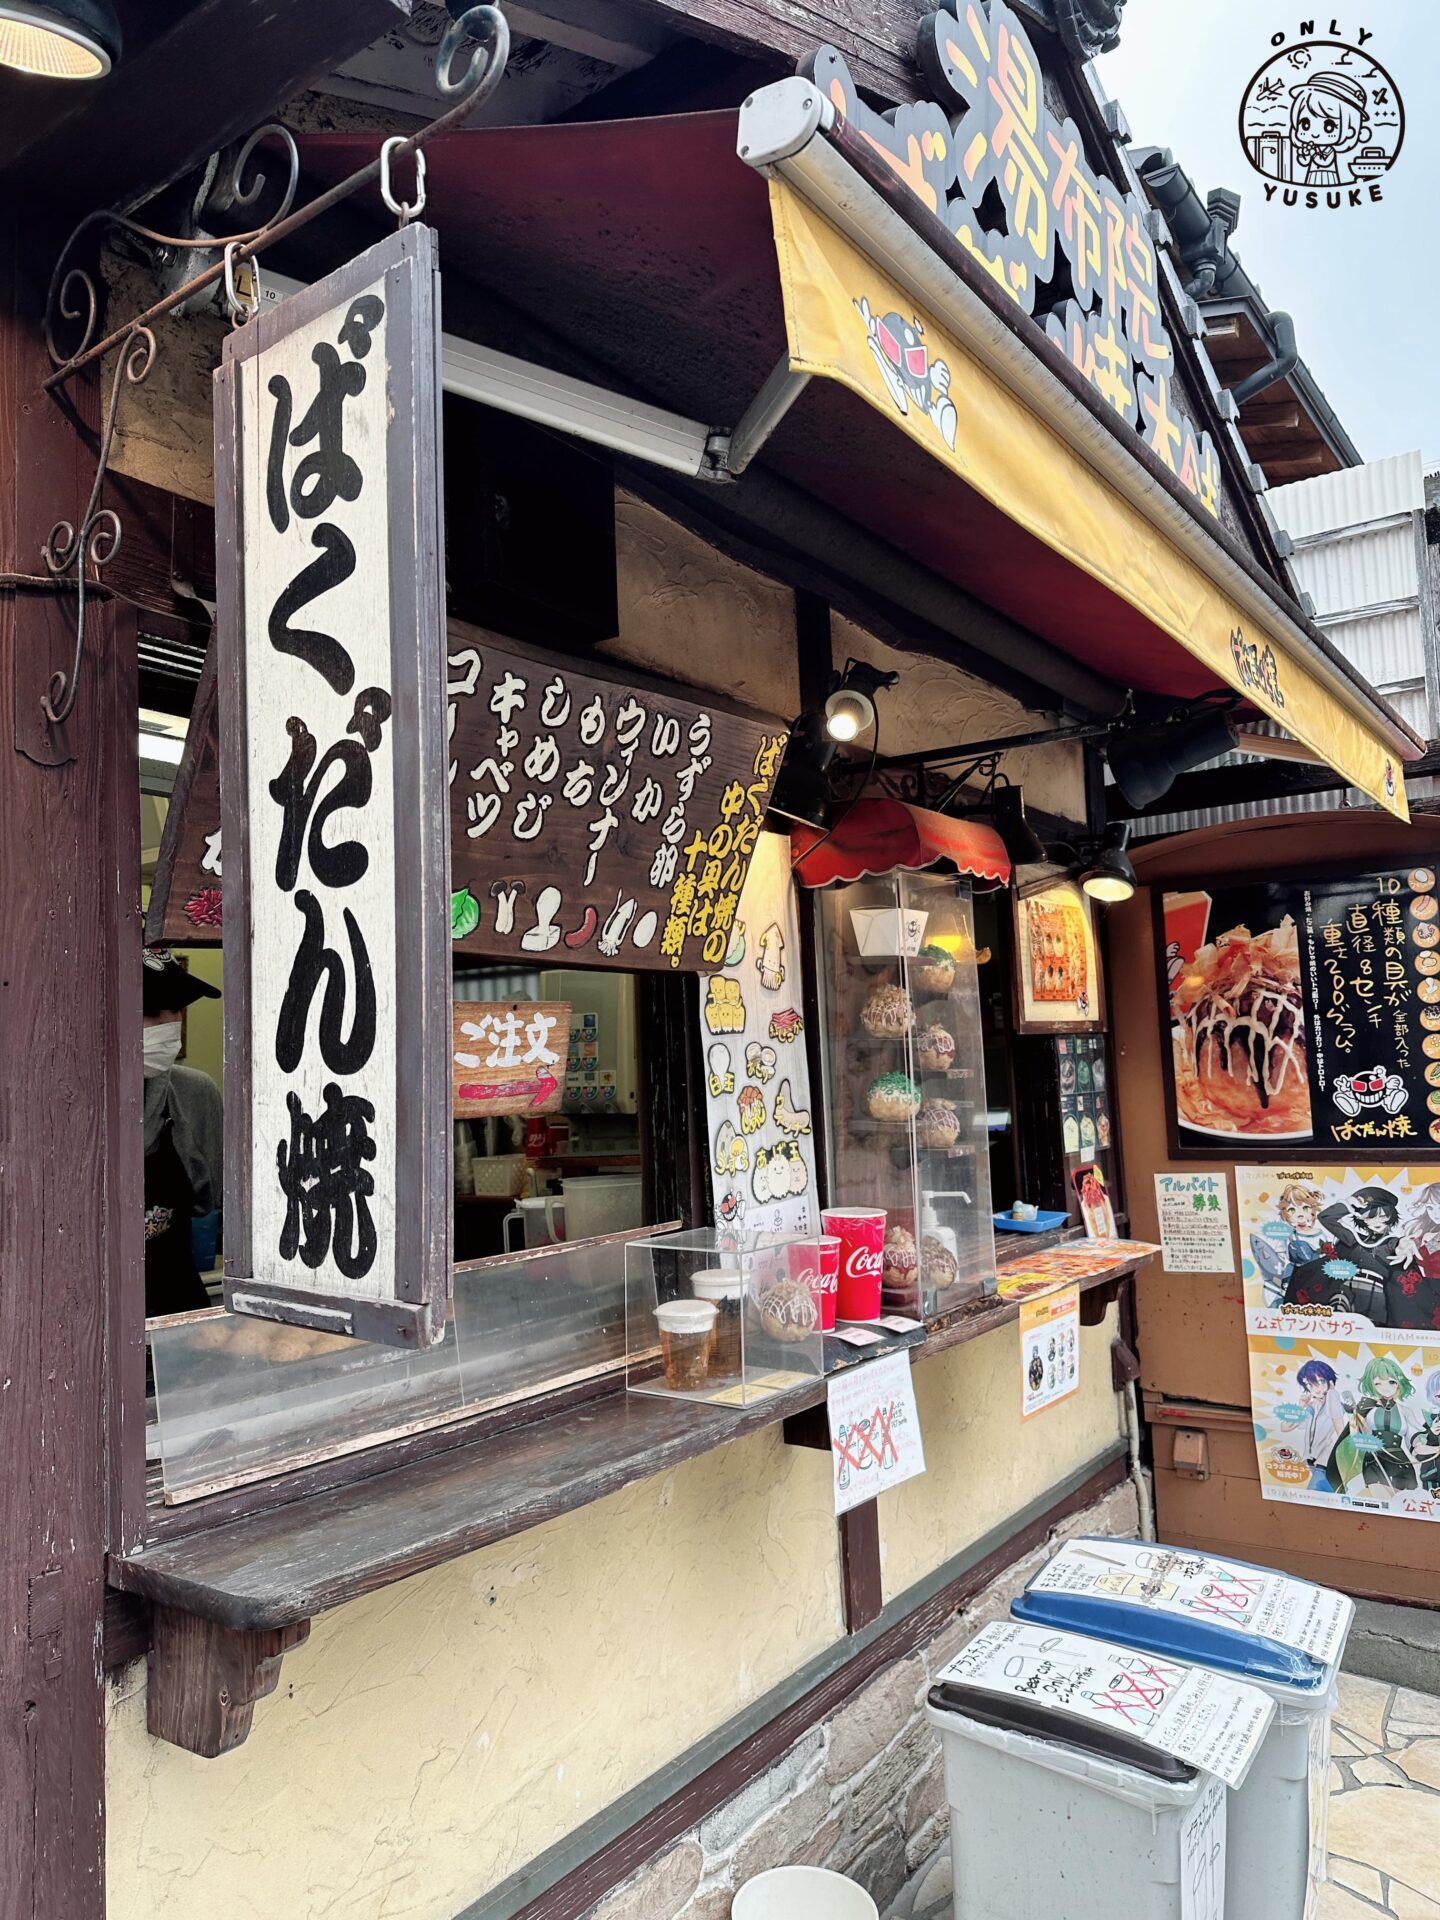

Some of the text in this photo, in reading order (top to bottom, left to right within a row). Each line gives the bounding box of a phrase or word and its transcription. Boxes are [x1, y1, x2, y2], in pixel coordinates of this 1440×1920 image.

[944, 5, 1173, 360] 湯布院
[267, 294, 394, 1280] ばくだん焼
[467, 671, 526, 840] キャベツ
[513, 676, 571, 840] しめじ
[563, 695, 607, 807] もち
[583, 698, 647, 888] ウィンナー
[631, 713, 681, 823] いか
[650, 712, 713, 888] うずら卵
[687, 780, 745, 938] 中の具は
[702, 731, 788, 964] ばくだん焼の
[1345, 903, 1383, 1029] 直径8センチ
[453, 1011, 561, 1069] ご注文
[756, 1141, 801, 1169] あげ玉
[1160, 1176, 1219, 1193] アルバイト
[1330, 1114, 1418, 1142] ばくだん焼
[1254, 1315, 1365, 1336] 公式アンバサダー
[1402, 1497, 1440, 1517] 公式
[947, 1638, 992, 1674] プラスチック
